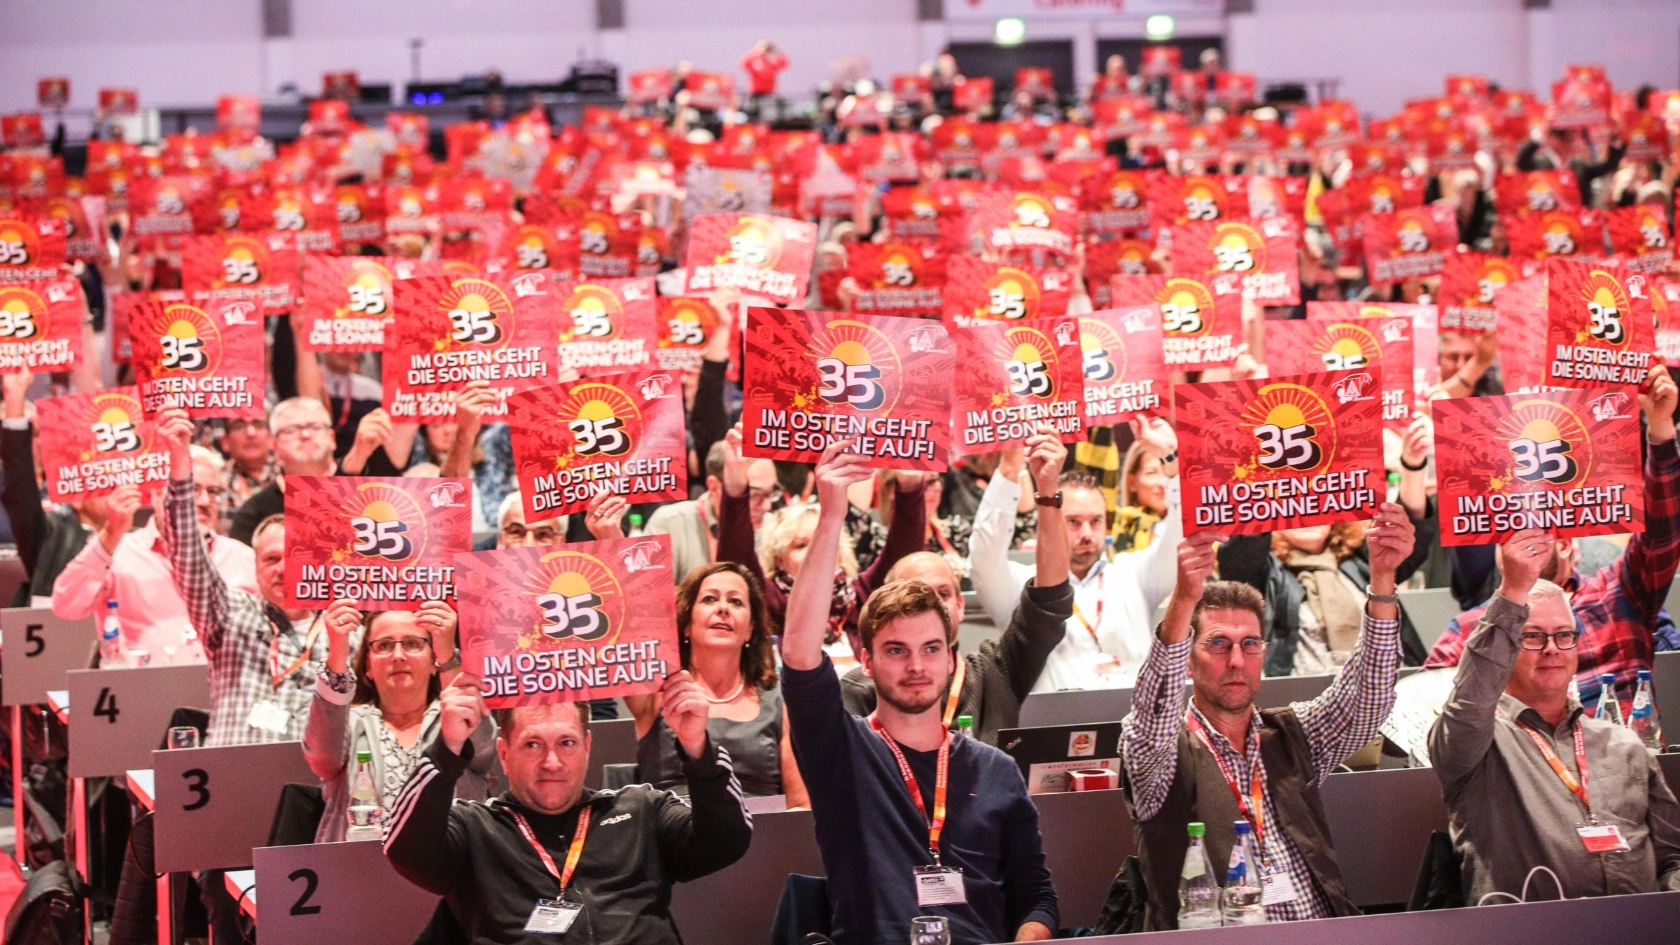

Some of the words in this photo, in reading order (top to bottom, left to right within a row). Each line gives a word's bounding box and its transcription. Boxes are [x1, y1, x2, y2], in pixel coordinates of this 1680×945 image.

[1184, 196, 1220, 222] 35
[222, 258, 260, 283] 35
[1213, 245, 1255, 271] 35
[881, 262, 915, 286] 35
[347, 284, 387, 315] 35
[989, 288, 1026, 319] 35
[1478, 279, 1494, 303] 3
[0, 310, 36, 338] 35
[449, 309, 498, 343] 35
[570, 308, 612, 336] 35
[668, 318, 706, 344] 35
[1161, 303, 1202, 333] 35
[1587, 302, 1624, 341] 35
[159, 336, 205, 369] 35
[411, 353, 431, 369] IM
[433, 350, 493, 368] OSTEN
[494, 346, 542, 363] GEHT
[1082, 348, 1112, 380] 5
[1556, 344, 1572, 361] IM
[1573, 348, 1618, 366] OSTEN
[1618, 351, 1651, 368] GEHT
[199, 376, 248, 392] GEHT
[408, 369, 436, 385] DIE
[438, 364, 501, 383] SONNE
[503, 362, 547, 379] AUF!
[817, 358, 880, 406] 35
[1005, 359, 1050, 395] 35
[1551, 361, 1573, 379] DIE
[1574, 364, 1621, 382] SONNE
[1621, 369, 1650, 384] AUF
[208, 392, 253, 408] AUF!
[1109, 379, 1154, 398] GEHT
[1119, 394, 1160, 413] AUF!
[391, 402, 418, 416] DIE
[420, 402, 457, 416] SON
[761, 409, 786, 428] IM
[790, 412, 867, 436] OSTEN
[870, 417, 931, 438] GEHT
[967, 410, 989, 428] IM
[991, 403, 1049, 424] OSTEN
[1049, 400, 1077, 417] GEHT
[91, 421, 139, 452] 35
[569, 416, 626, 454] 35
[755, 428, 790, 449] DIE
[878, 438, 935, 460] AUF!
[964, 427, 994, 445] DIE
[1057, 417, 1081, 434] AUF!
[1254, 424, 1318, 467] 35
[59, 465, 79, 480] IM
[81, 457, 135, 477] OSTEN
[136, 451, 170, 468] GEH
[1509, 438, 1572, 480] 35
[57, 480, 84, 495] DIE
[87, 469, 145, 490] SONNE
[146, 466, 170, 482] AU
[533, 475, 555, 493] IM
[557, 462, 621, 486] OSTEN
[624, 457, 671, 477] GEHT
[1201, 484, 1228, 504] IM
[1232, 476, 1308, 501] OSTEN
[1312, 469, 1368, 493] GEHT
[532, 493, 562, 512] DIE
[563, 478, 631, 503] SONNE
[633, 474, 677, 494] AUF!
[1195, 504, 1234, 525] DIE
[1238, 496, 1319, 521] SONNE
[1323, 489, 1375, 513] AUF!
[1457, 496, 1485, 514] IM
[1488, 489, 1564, 513] OSTEN
[1567, 484, 1625, 505] GEHT
[1452, 515, 1490, 534] DIE
[1494, 508, 1576, 532] SONNE
[1579, 503, 1632, 525] AUF!
[352, 516, 408, 558] 35
[302, 564, 326, 582] IM
[329, 565, 399, 583] OSTEN
[401, 566, 455, 584] GEHT
[296, 582, 329, 599] DIE
[332, 583, 408, 601] SONNE
[410, 584, 458, 601] AUF!
[536, 592, 604, 638] 35
[25, 624, 45, 658] 5
[483, 656, 513, 676] IM
[515, 647, 597, 670] OSTEN
[601, 640, 660, 664] GEHT
[480, 676, 518, 698] DIE
[523, 667, 610, 694] SONNE
[613, 660, 667, 685] AUF!
[93, 686, 120, 723] 4
[182, 768, 210, 811] 3
[288, 868, 321, 916] 2
